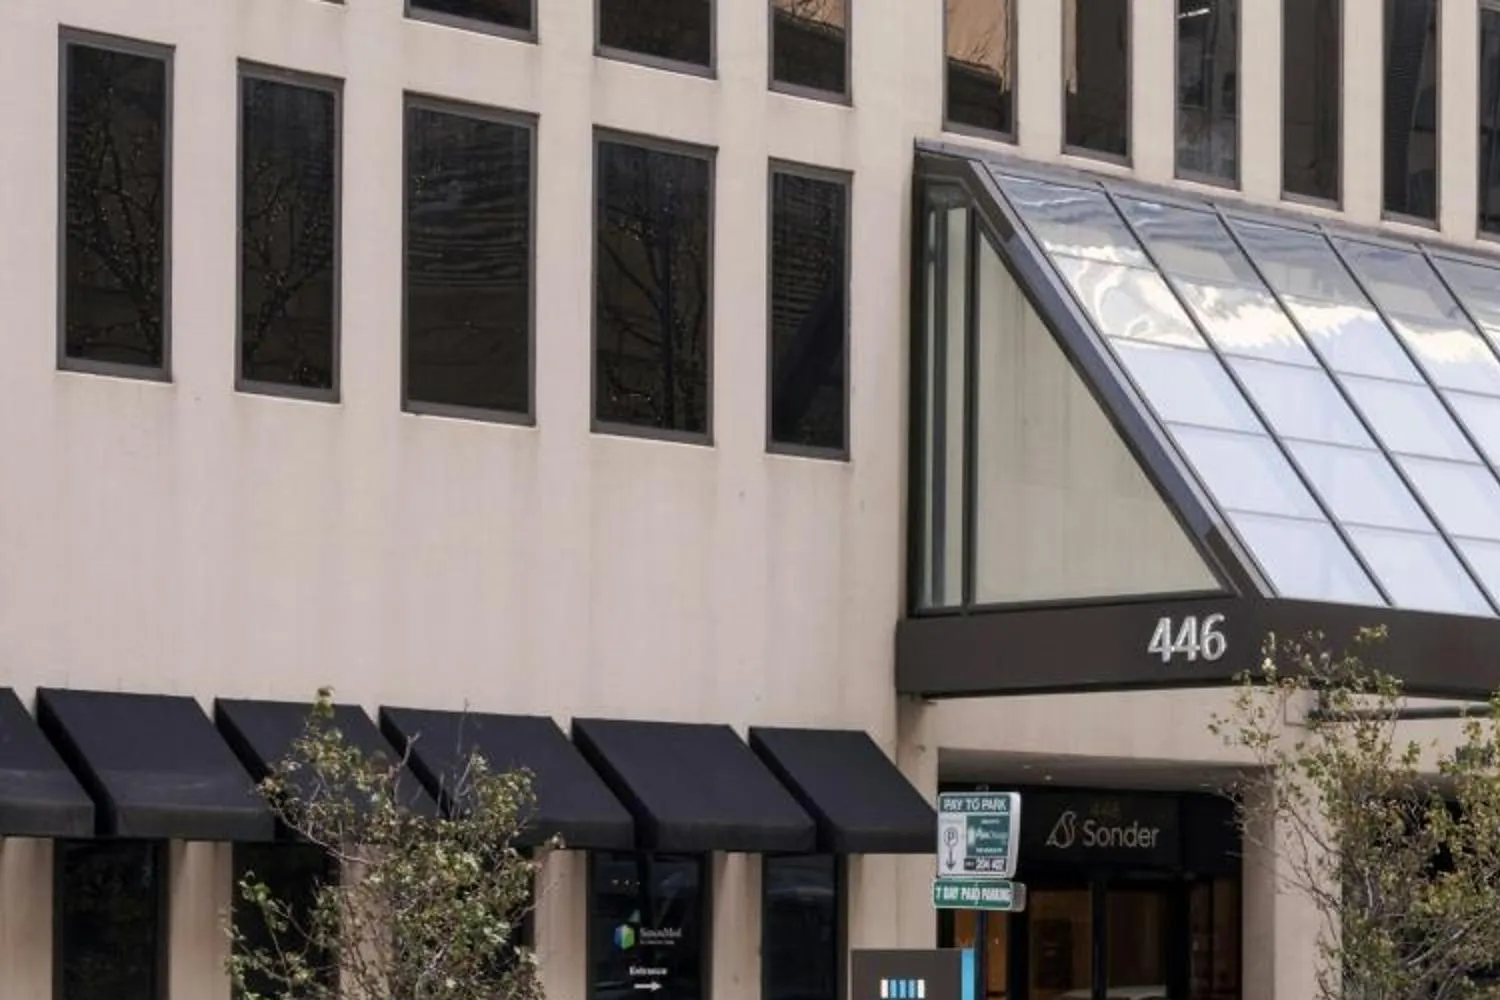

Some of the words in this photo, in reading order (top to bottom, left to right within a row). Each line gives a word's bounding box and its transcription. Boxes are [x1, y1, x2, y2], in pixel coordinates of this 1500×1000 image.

[1147, 612, 1228, 663] 446
[943, 798, 962, 812] PAY
[966, 798, 980, 811] TO
[981, 798, 1008, 812] PARK
[1082, 819, 1161, 848] Sonder
[961, 887, 980, 901] PAID
[629, 966, 668, 976] Entrance
